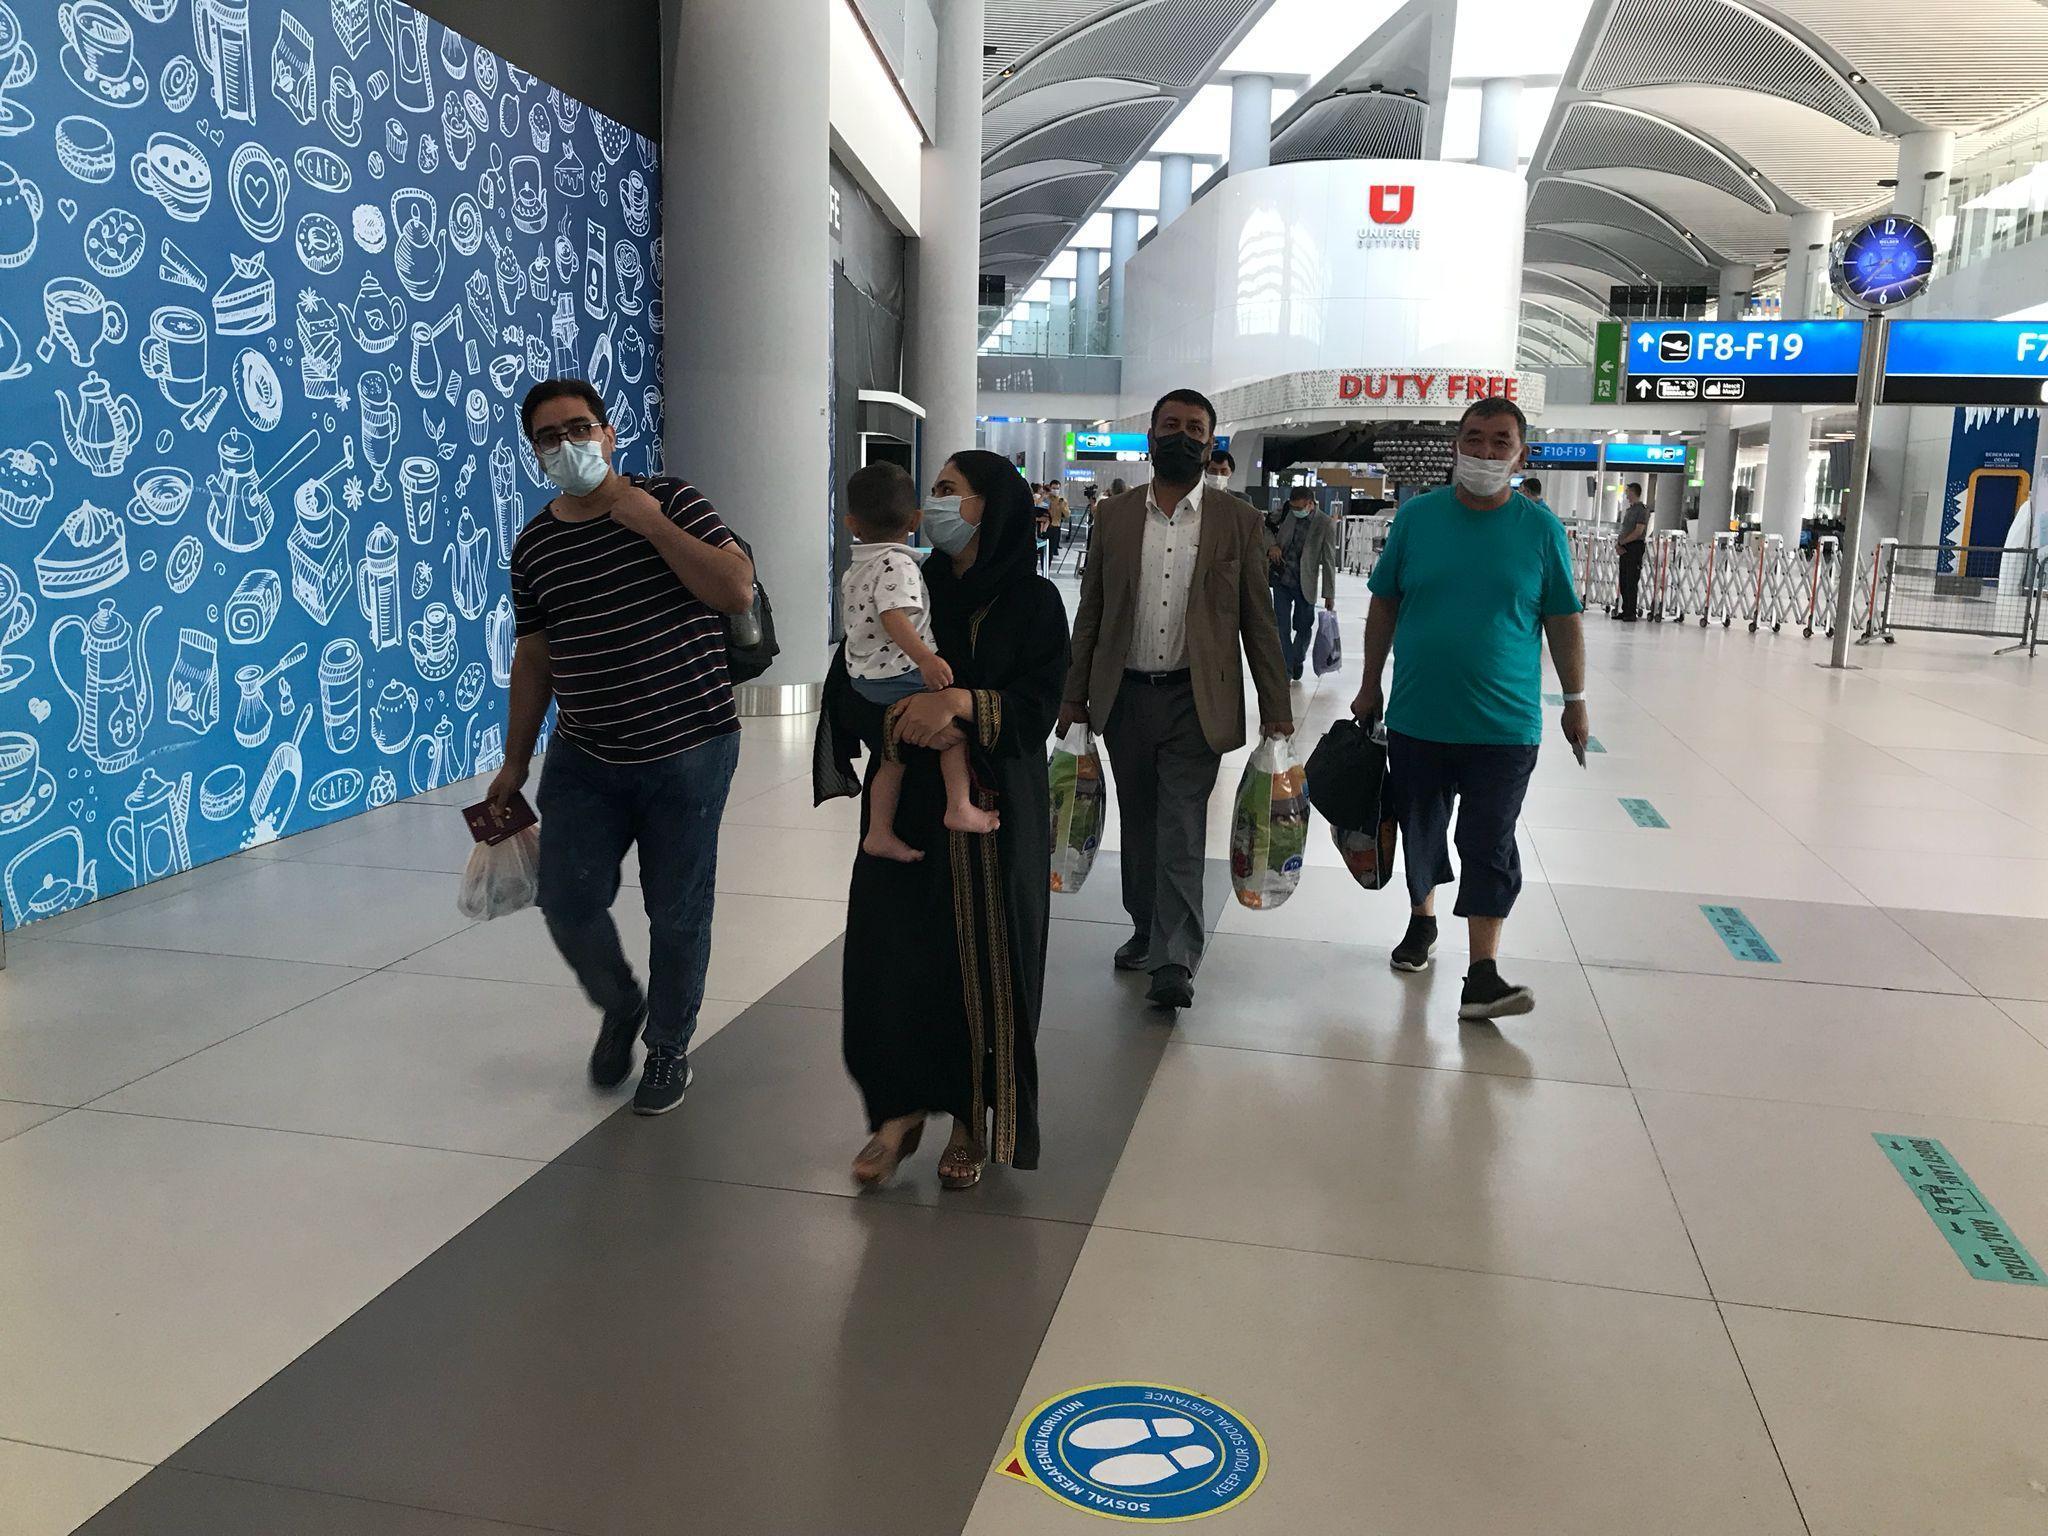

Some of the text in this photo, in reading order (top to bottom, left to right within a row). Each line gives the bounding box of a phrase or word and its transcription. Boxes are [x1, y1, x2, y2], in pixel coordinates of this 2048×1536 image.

[308, 156, 337, 181] CAFE
[1358, 228, 1421, 239] UNIFREE
[1885, 219, 1896, 235] 12
[1879, 289, 1887, 305] 6
[1697, 333, 1804, 361] F8-F19
[1339, 374, 1518, 401] DUTY FREE
[1544, 446, 1586, 457] F10-F19
[327, 558, 343, 591] CAFE
[322, 778, 349, 801] CAFE
[1927, 1164, 1964, 1186] LANE
[1988, 1244, 2038, 1281] ROTASI
[1032, 1400, 1151, 1512] SOSYAL MESAFENİZİ KORUYUN
[1144, 1391, 1249, 1497] KEEP YOUR SOCIAL DISTANCE
